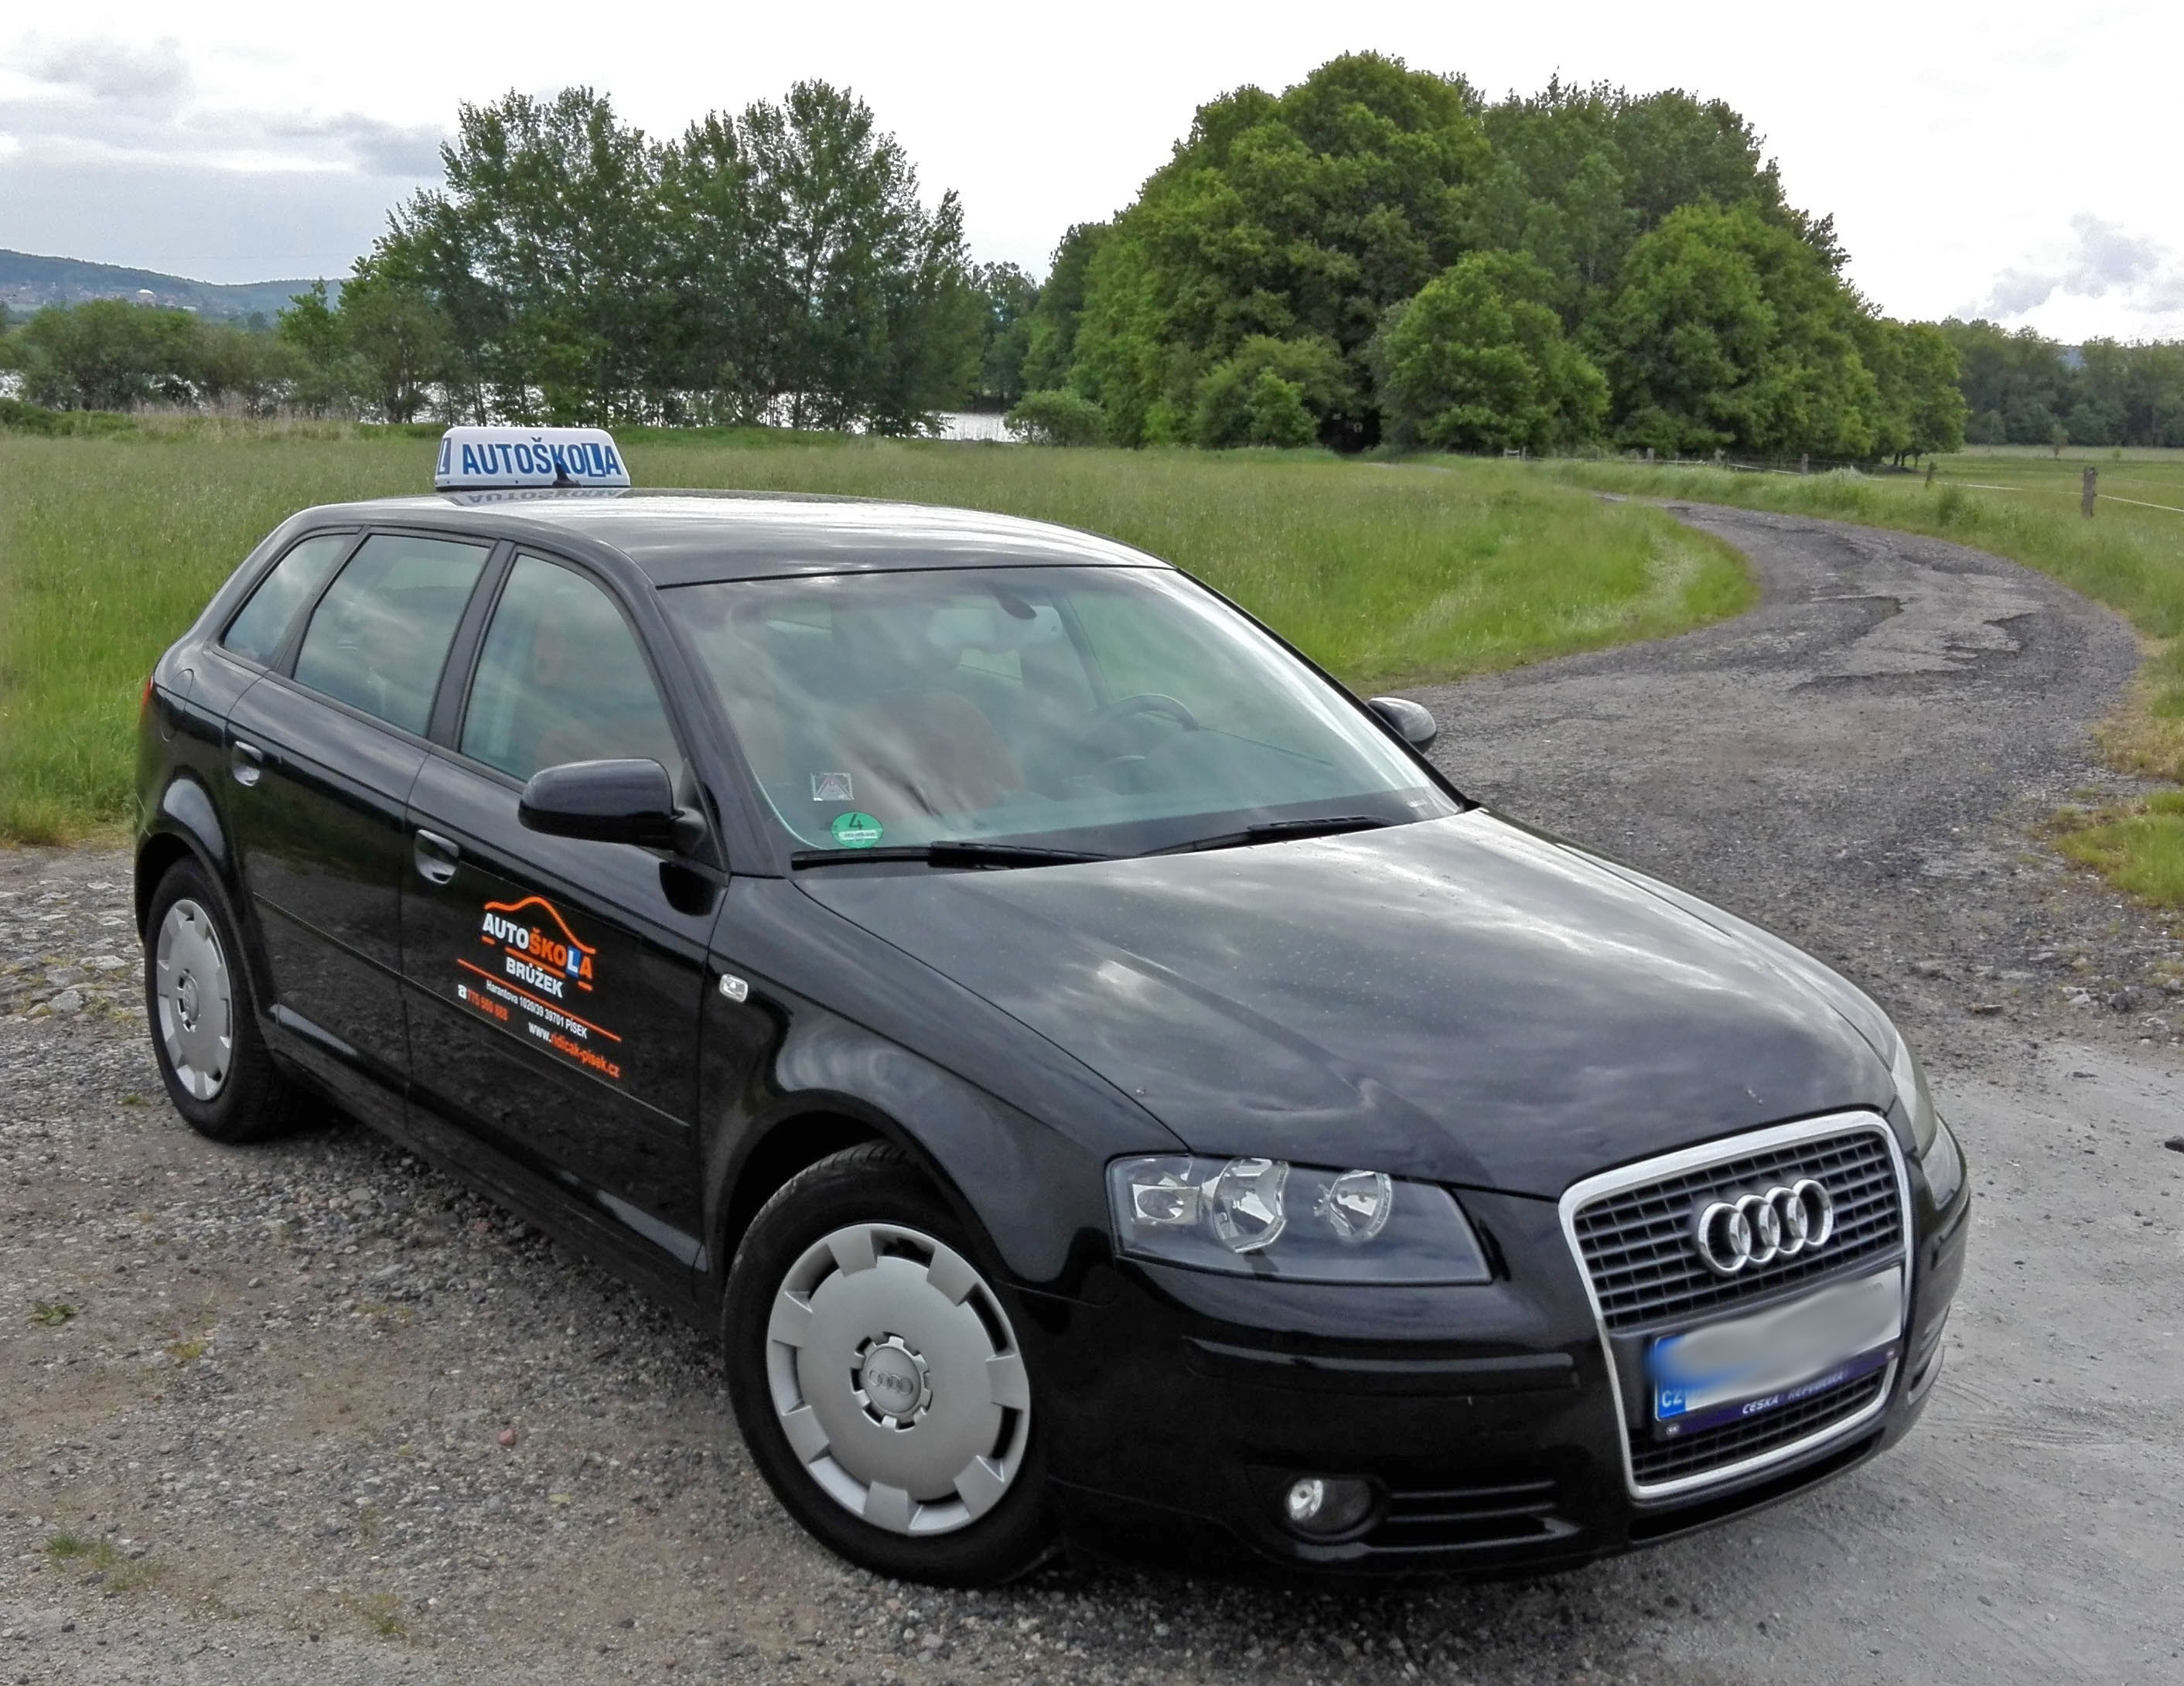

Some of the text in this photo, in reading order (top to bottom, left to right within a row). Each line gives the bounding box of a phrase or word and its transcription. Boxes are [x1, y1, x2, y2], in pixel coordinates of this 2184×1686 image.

[462, 437, 621, 477] AUTOŠKOLA
[849, 814, 864, 830] 4
[483, 913, 592, 978] AUTOŠKOLA
[506, 957, 564, 998] BRŮŽEK
[1662, 1390, 1682, 1408] CZ
